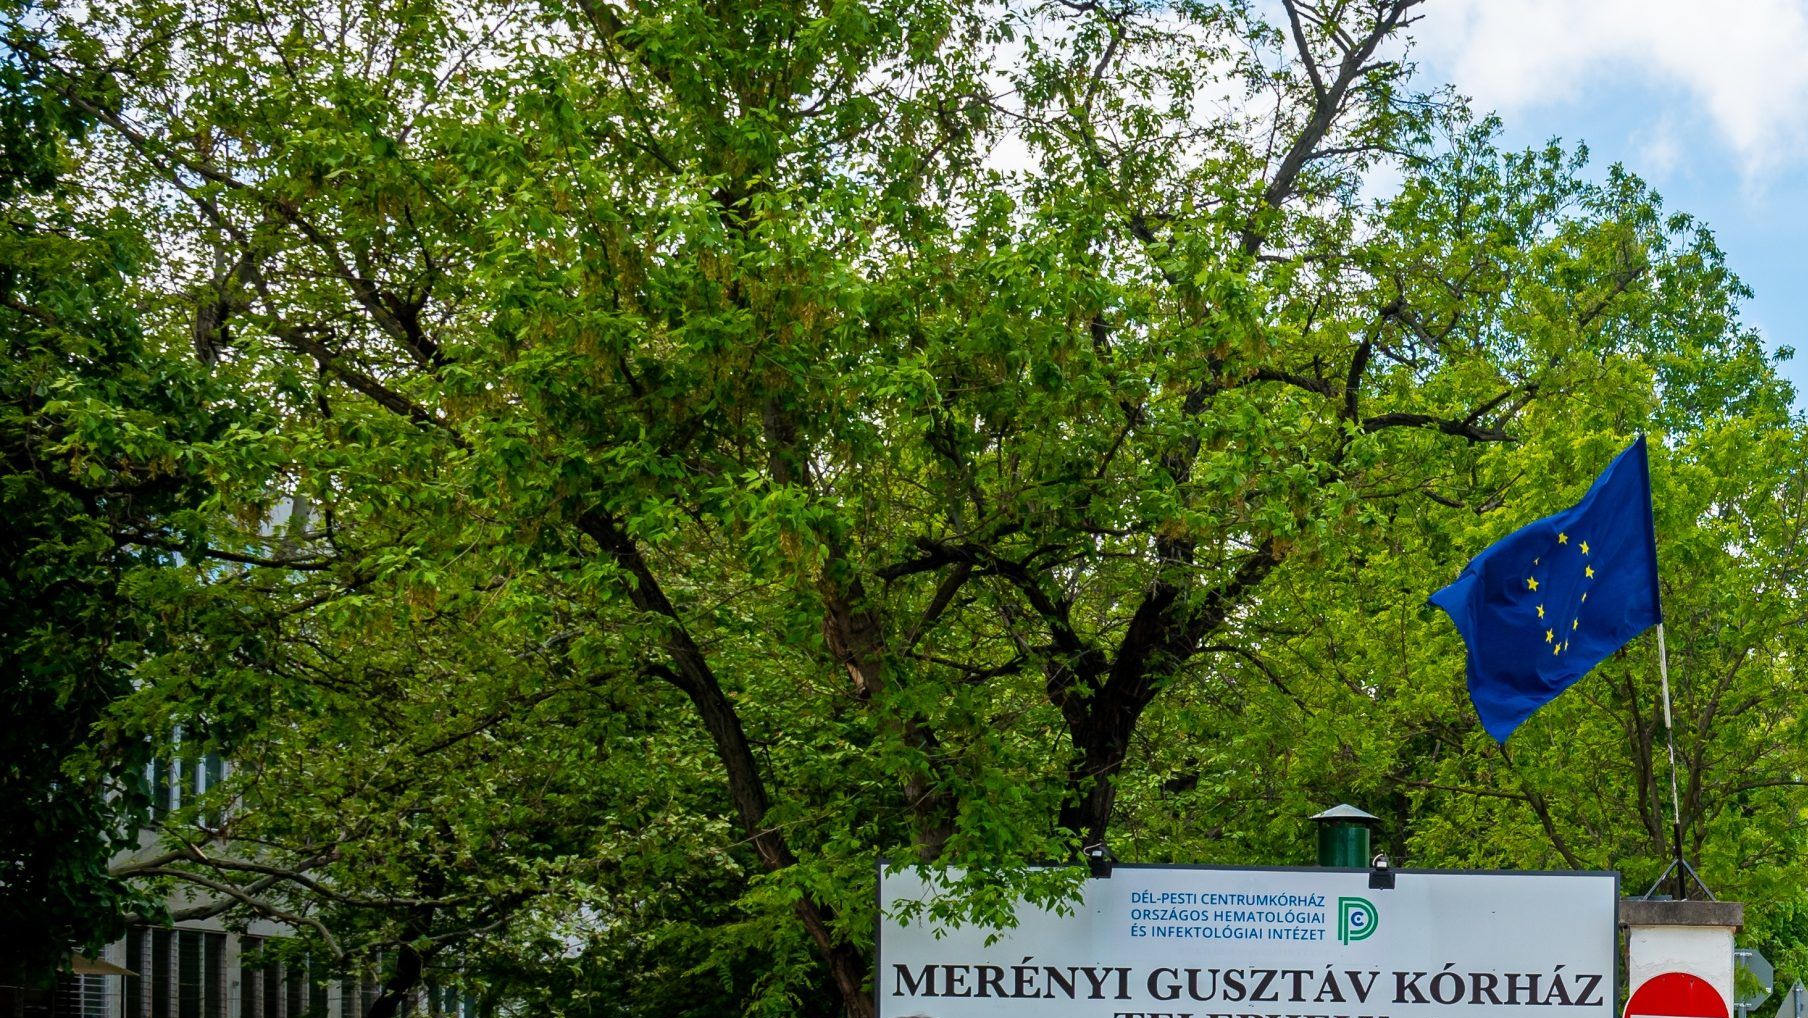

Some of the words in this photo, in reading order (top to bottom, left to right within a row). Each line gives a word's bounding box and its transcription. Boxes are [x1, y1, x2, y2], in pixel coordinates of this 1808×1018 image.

[1131, 889, 1197, 904] DÉL-PESTI
[1201, 892, 1325, 907] CENTRUMKÓRHÁZ
[1131, 907, 1209, 922] ORSZÁGOS
[1214, 908, 1325, 924] HEMATOLÓGIAI
[1131, 923, 1147, 937] ÉS
[1152, 924, 1263, 939] INFEKTOLÓGIAI
[1268, 926, 1325, 940] INTÉZET
[892, 956, 1132, 1001] MERÉNYI
[1147, 963, 1380, 1003] GUSZTÁV
[1391, 963, 1604, 1006] KÓRHÁZ
